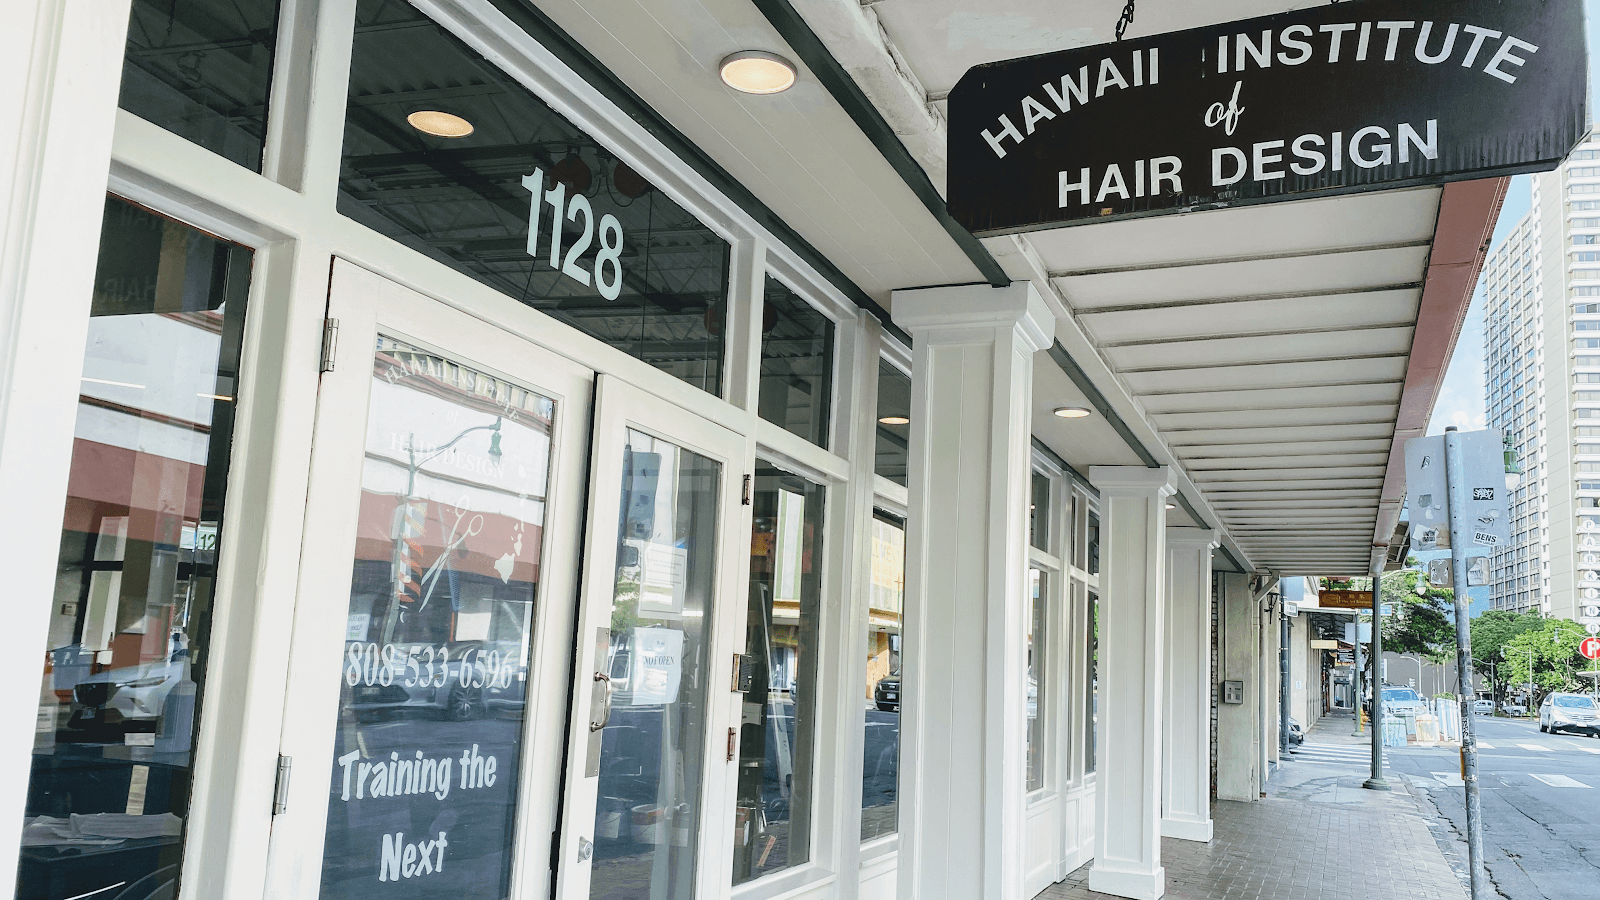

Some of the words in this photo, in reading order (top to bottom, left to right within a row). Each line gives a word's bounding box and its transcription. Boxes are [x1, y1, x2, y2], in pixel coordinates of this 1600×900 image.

[980, 48, 1160, 160] HAWAII
[1217, 20, 1539, 84] INSTITUTE
[1204, 81, 1245, 136] of
[1057, 155, 1183, 208] HAIR
[1210, 119, 1438, 187] DESIGN
[521, 166, 624, 301] 1128
[384, 359, 449, 386] HAWAII
[452, 365, 519, 421] INSTITUTE
[446, 410, 459, 427] of
[442, 448, 505, 480] DESIGN
[1583, 521, 1596, 634] PARKING
[346, 641, 513, 689] 808-533-6596
[643, 656, 657, 665] NOT
[658, 656, 675, 665] OPEN
[338, 749, 452, 801] Training
[459, 743, 497, 789] the
[379, 831, 448, 882] Next
